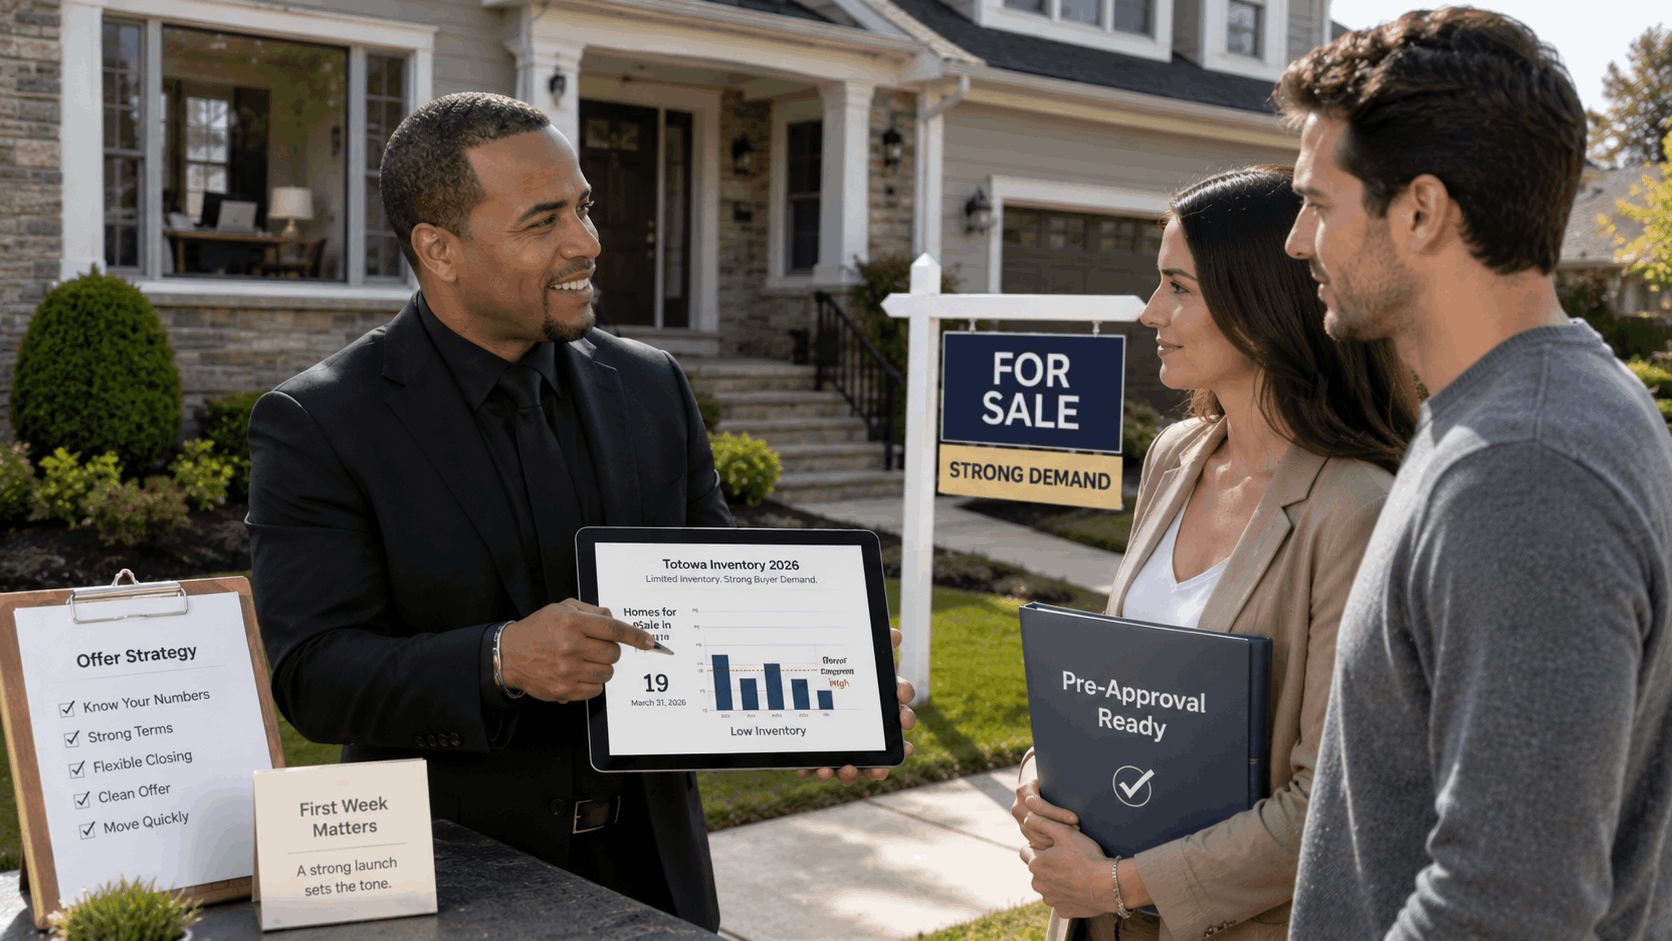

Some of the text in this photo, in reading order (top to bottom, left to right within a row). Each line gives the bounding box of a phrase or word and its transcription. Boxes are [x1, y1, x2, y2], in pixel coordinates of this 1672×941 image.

[993, 352, 1070, 388] FOR
[982, 390, 1080, 430] SALE
[949, 461, 1111, 490] STRONG DEMAND
[663, 559, 800, 572] Totowa Inventory 2026
[646, 575, 818, 585] Limited Inventory. Strong Buyer Demand.
[623, 607, 677, 617] Homes for
[76, 646, 197, 668] Offer Strategy
[643, 673, 669, 693] 19
[1062, 670, 1206, 713] Pre-Approval
[83, 690, 210, 713] Know Your Numbers
[631, 698, 687, 708] March 31, 2026
[88, 724, 173, 744] Strong Terms
[730, 726, 806, 737] Low Inventory
[1098, 707, 1167, 743] Ready
[93, 750, 193, 773] Flexible Closing
[98, 783, 171, 804] Clean Offer
[300, 796, 389, 817] First Week
[104, 811, 189, 834] Move Quickly
[313, 821, 378, 837] Matters
[296, 857, 398, 877] A strong launch
[305, 879, 392, 897] sets the tone.
